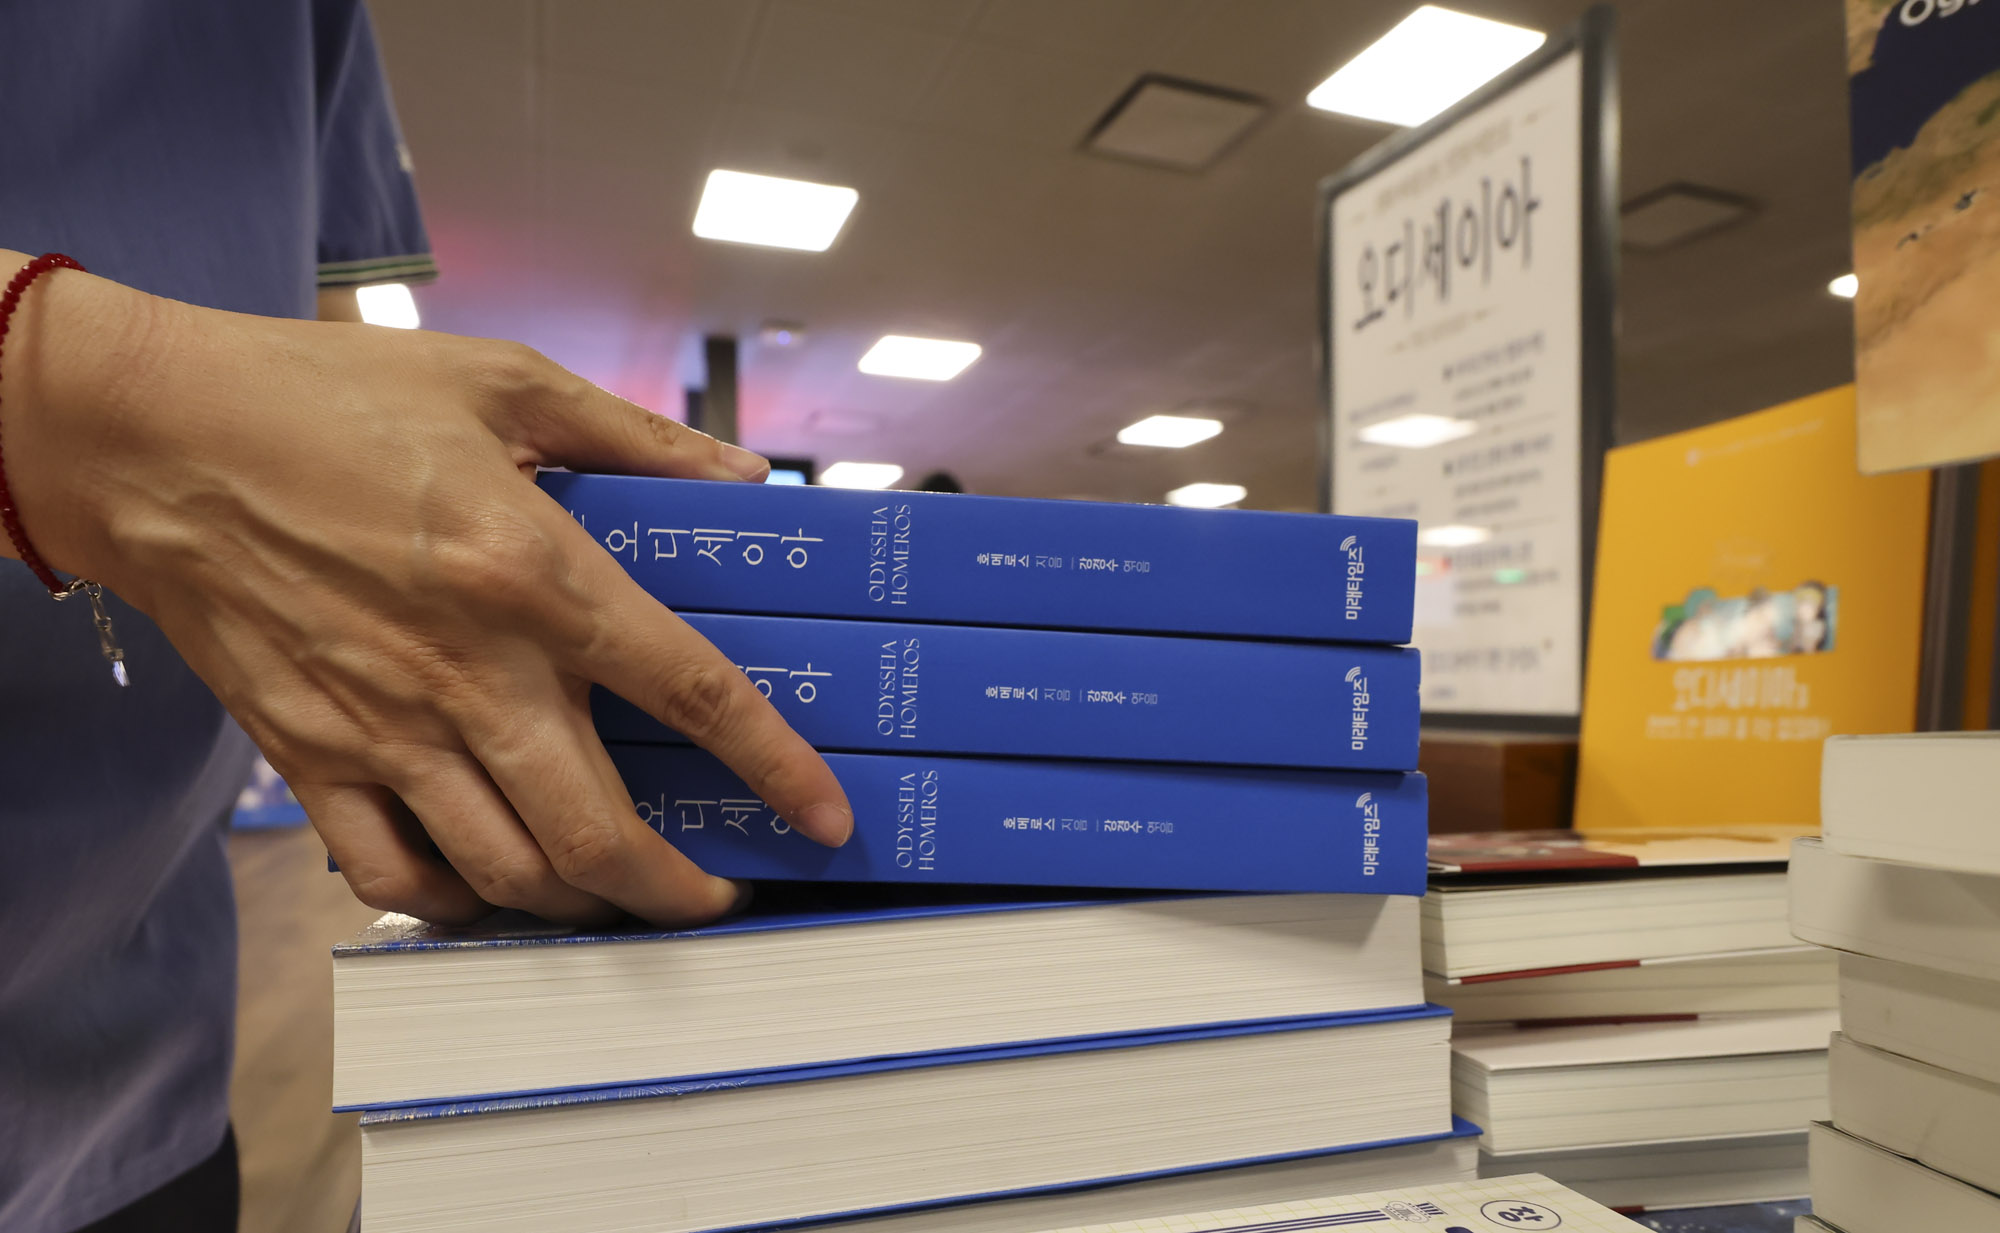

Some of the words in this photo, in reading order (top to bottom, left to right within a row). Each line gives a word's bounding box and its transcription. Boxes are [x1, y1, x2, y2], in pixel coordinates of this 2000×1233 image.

[1353, 155, 1542, 332] 오디세이아
[604, 521, 824, 569] 오디세이아
[868, 506, 889, 602] ODYSSEIA
[891, 504, 911, 605] HOMEROS
[976, 552, 1030, 568] 호메로스
[1035, 555, 1063, 569] 지음
[1078, 556, 1120, 572] 강경수
[877, 640, 898, 736] ODYSSEIA
[899, 638, 920, 739] HOMEROS
[985, 685, 1038, 701] 호메로스
[1043, 687, 1071, 702] 지음
[1087, 689, 1127, 704] 강경수
[896, 772, 916, 868] ODYSSEIA
[918, 770, 939, 871] HOMEROS
[1002, 816, 1056, 832] 호메로스
[1060, 818, 1088, 832] 지음
[1103, 819, 1144, 834] 강경수
